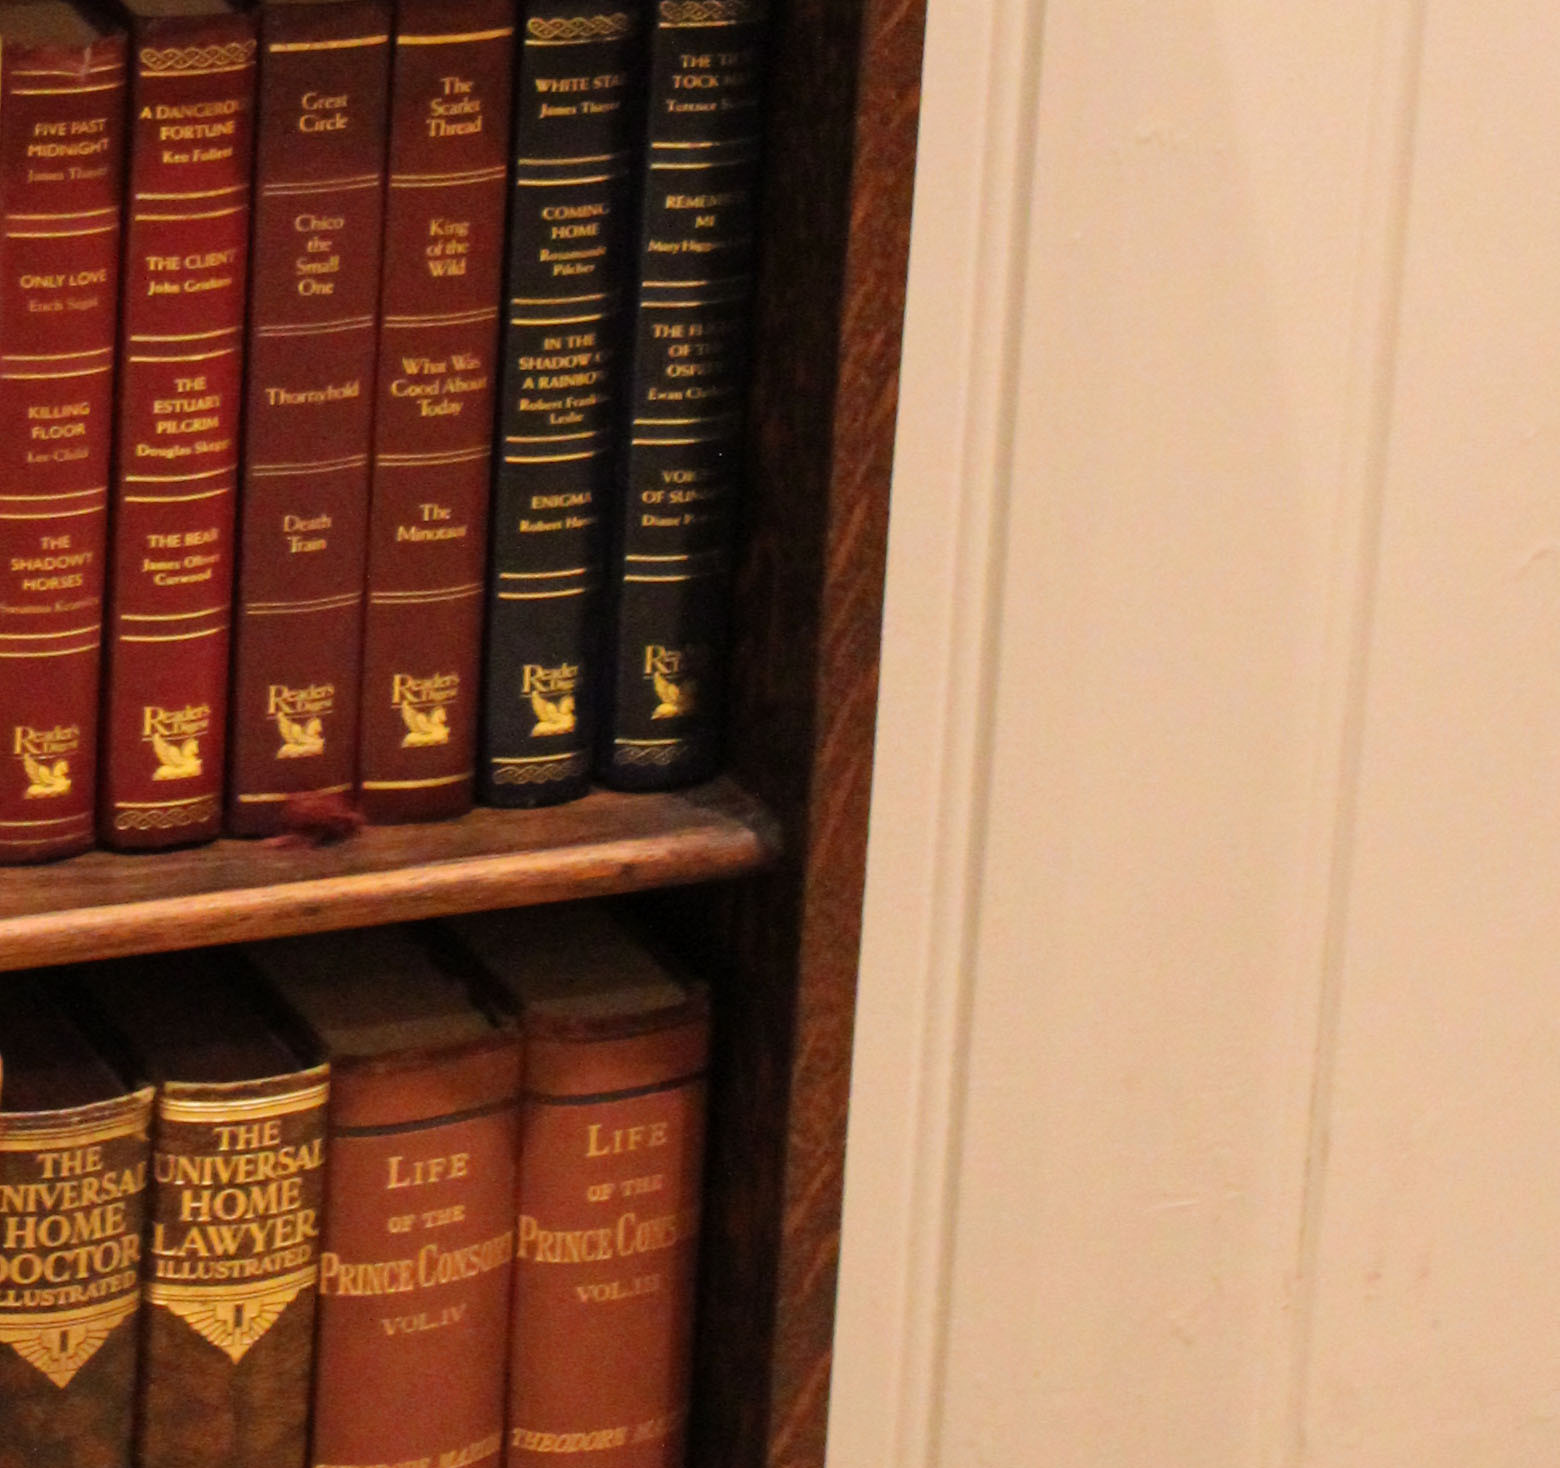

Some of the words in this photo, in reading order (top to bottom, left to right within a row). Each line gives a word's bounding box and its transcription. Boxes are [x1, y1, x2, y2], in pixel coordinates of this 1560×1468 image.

[441, 77, 474, 95] The
[536, 78, 590, 93] WHITE
[301, 92, 347, 109] Great
[139, 107, 152, 119] A
[300, 114, 348, 133] Circle
[426, 116, 482, 136] Thread
[429, 218, 470, 237] King
[307, 236, 332, 252] the
[145, 256, 180, 271] THE
[296, 256, 340, 275] Small
[428, 258, 466, 277] Wild
[69, 269, 107, 286] LOVE
[298, 278, 334, 296] One
[544, 337, 561, 350] IN
[567, 334, 596, 348] THE
[175, 377, 207, 392] THE
[391, 379, 439, 397] Good
[522, 376, 534, 389] A
[28, 402, 90, 419] KILLING
[417, 399, 463, 416] Today
[32, 423, 85, 439] FLOOR
[420, 504, 451, 521] The
[284, 515, 332, 532] Death
[40, 535, 71, 550] THE
[147, 534, 182, 548] THE
[22, 573, 83, 591] HORSES
[212, 1120, 282, 1151] THE
[586, 1122, 669, 1158] LIFE
[36, 1146, 104, 1180] THE
[154, 1138, 325, 1186] UNIVERSAL
[386, 1152, 470, 1190] LIFE
[586, 1183, 613, 1202] OF
[621, 1174, 663, 1196] THE
[180, 1177, 304, 1222] HOME
[3, 1202, 127, 1249] HOME
[388, 1216, 411, 1233] OF
[424, 1205, 466, 1229] THE
[152, 1209, 320, 1257] LAWYER
[517, 1215, 613, 1264] PRINCE
[156, 1245, 312, 1280] ILLUSTRATED
[319, 1251, 414, 1296] PRINCE
